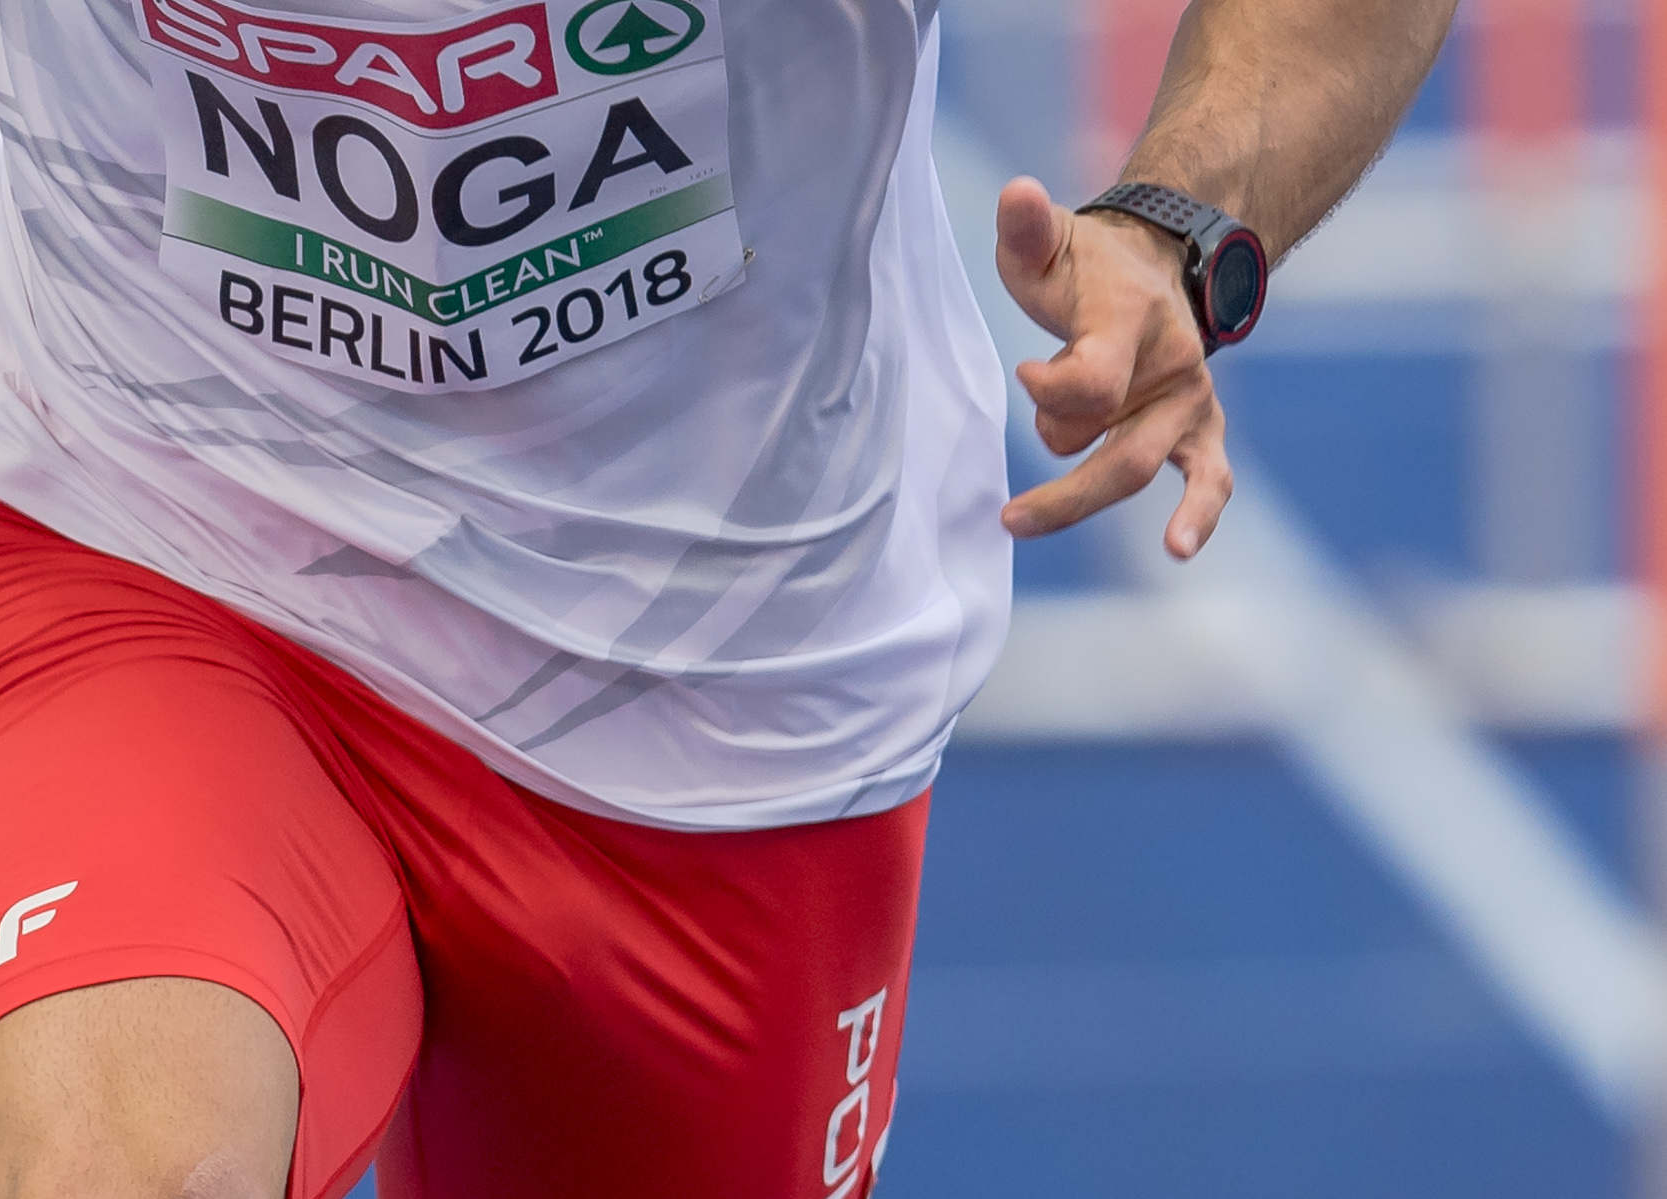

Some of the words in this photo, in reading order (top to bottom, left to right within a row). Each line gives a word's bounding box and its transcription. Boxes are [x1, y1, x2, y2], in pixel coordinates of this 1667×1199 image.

[184, 68, 694, 247] NOGA
[219, 269, 489, 385] BERLIN
[511, 249, 693, 366] 2018
[295, 232, 304, 267] I
[322, 241, 414, 308] RUN
